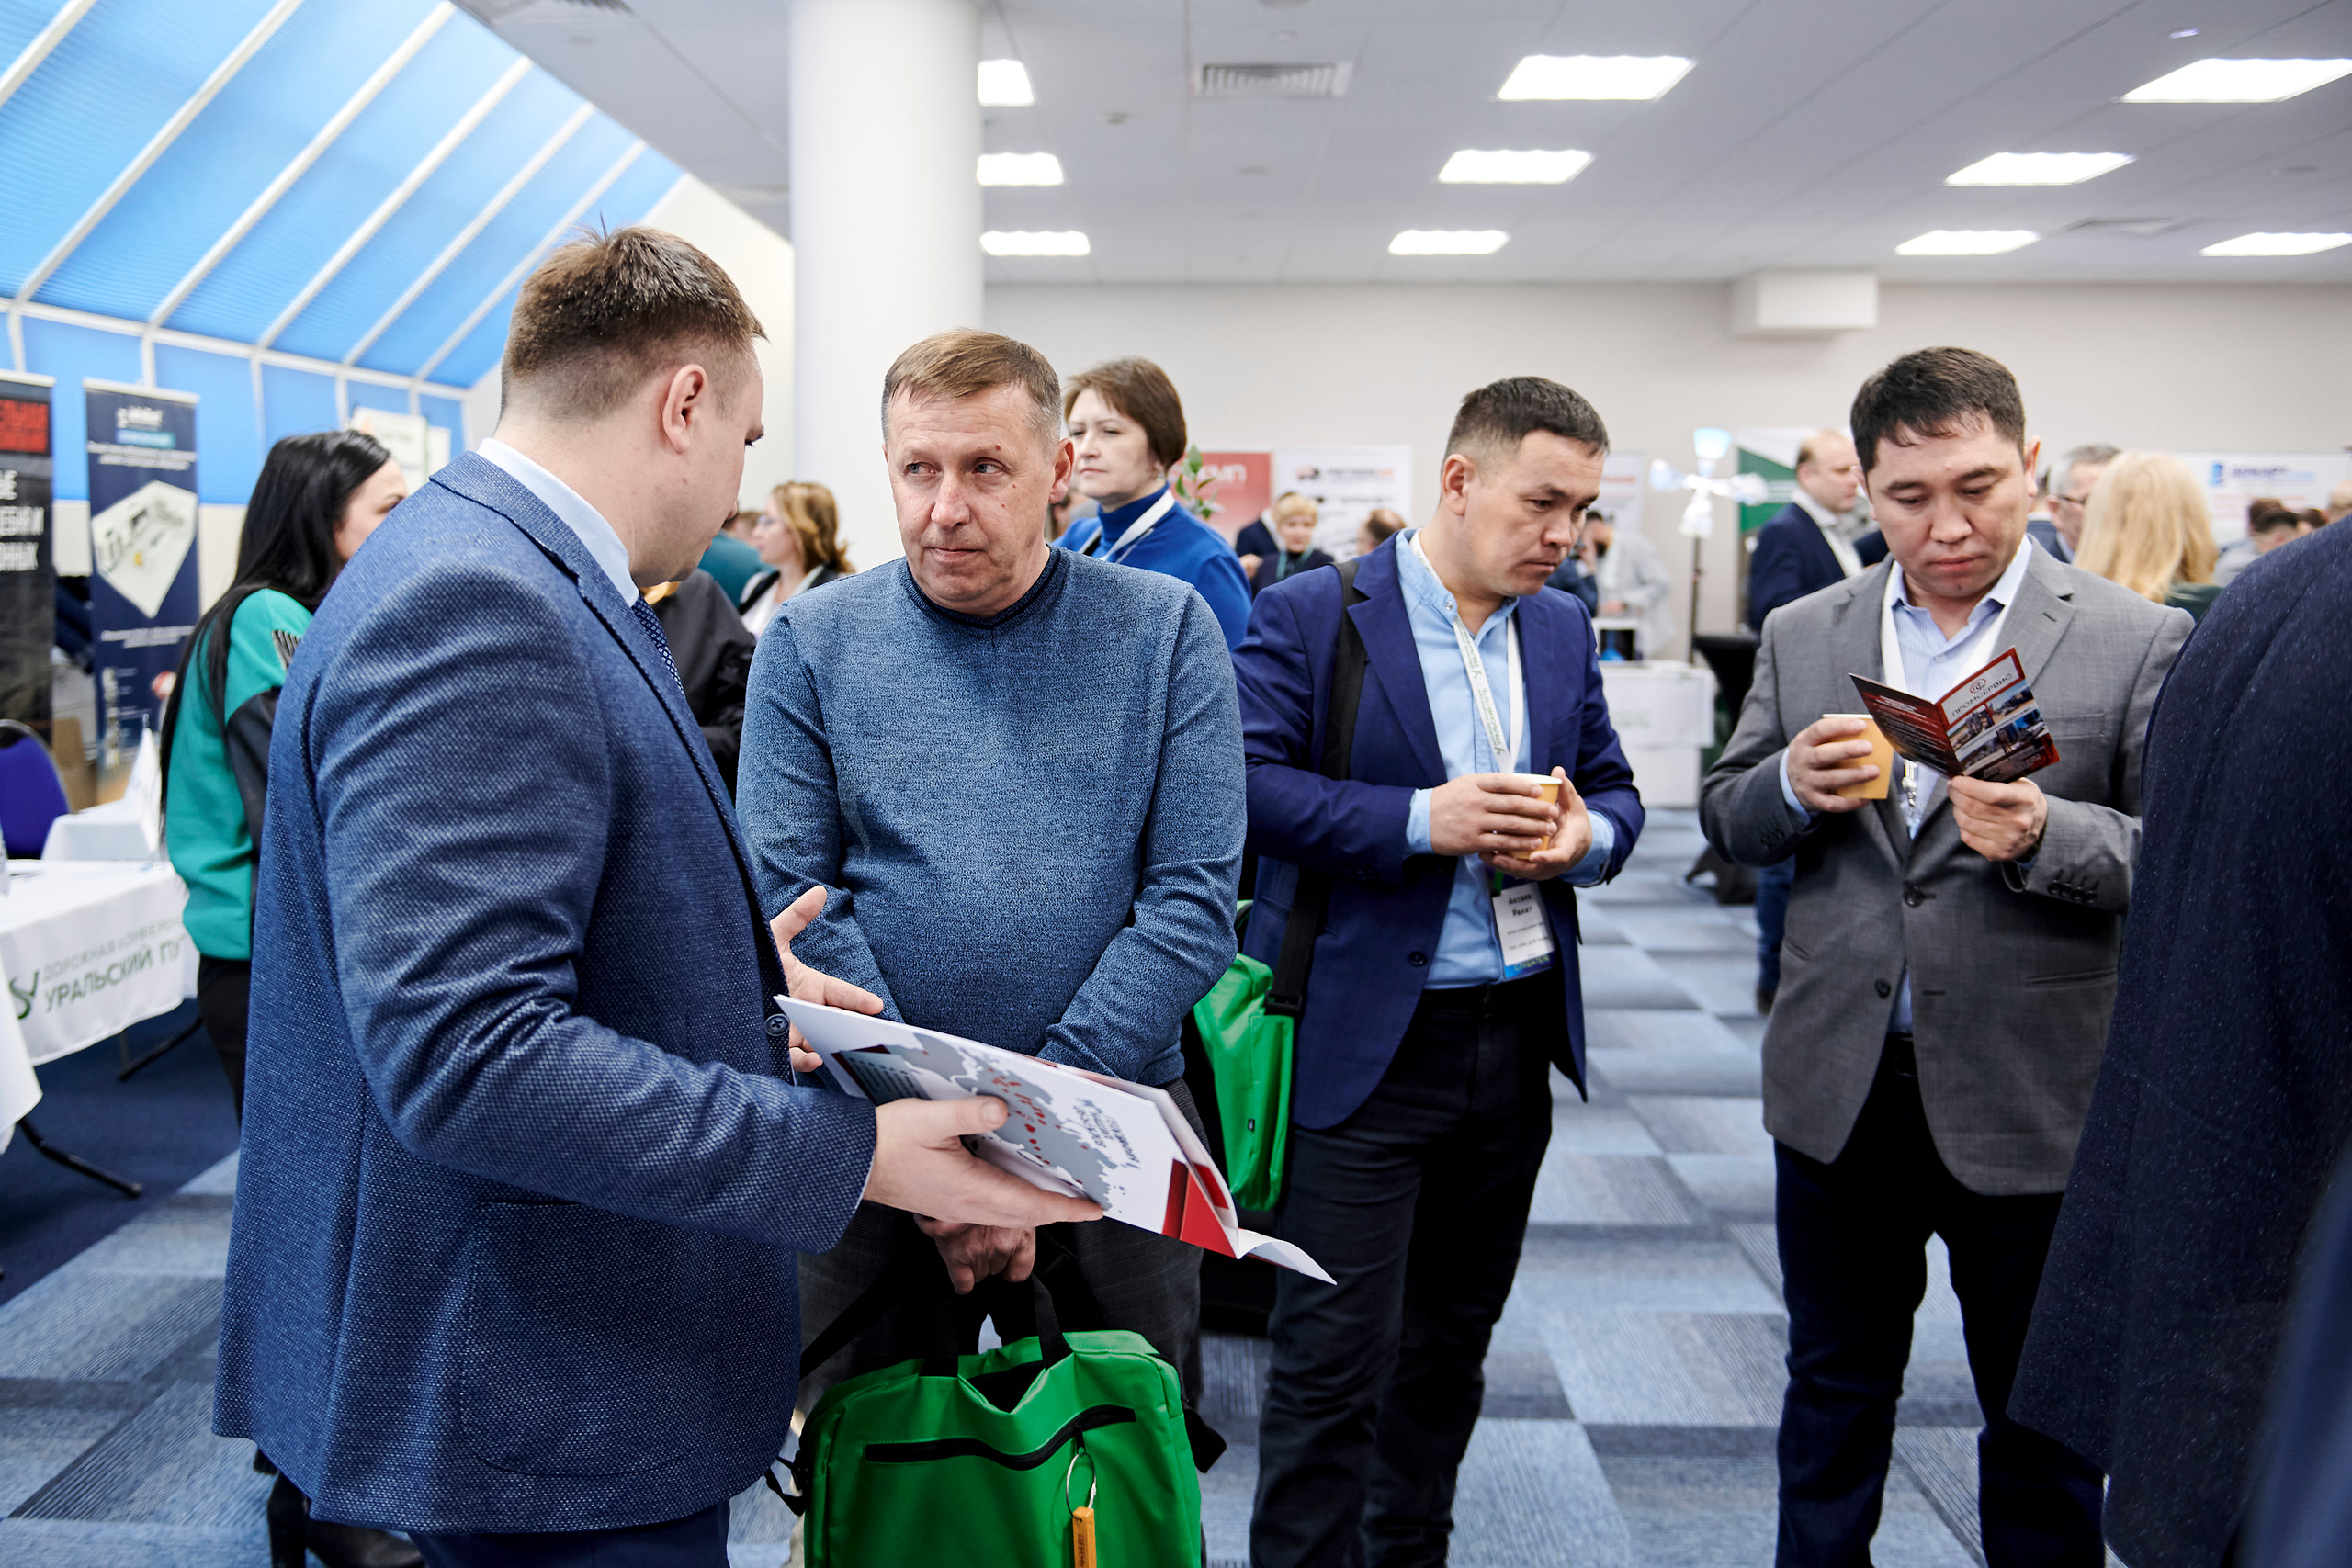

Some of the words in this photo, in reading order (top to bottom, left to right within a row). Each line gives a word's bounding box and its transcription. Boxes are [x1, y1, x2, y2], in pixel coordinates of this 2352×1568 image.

[1951, 672, 2013, 717] ПРОМСЕРВИС
[43, 940, 116, 982] ДОРОЖНАЯ
[44, 943, 153, 1013] УРАЛЬСКИЙ
